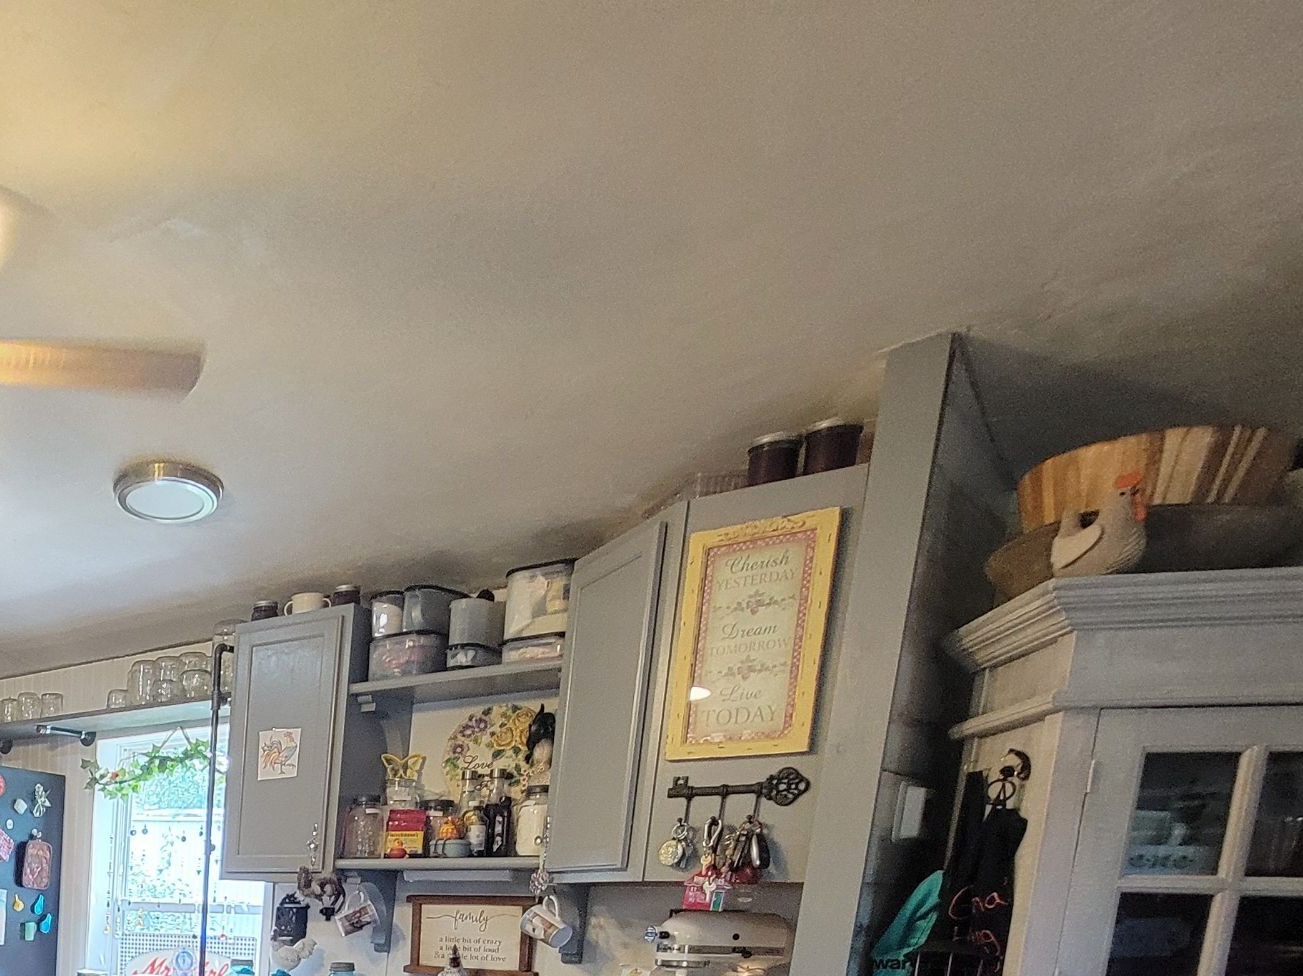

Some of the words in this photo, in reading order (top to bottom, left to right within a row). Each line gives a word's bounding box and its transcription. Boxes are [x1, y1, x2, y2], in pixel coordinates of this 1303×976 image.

[725, 550, 791, 575] Cherish
[716, 568, 798, 592] YESTERDAY
[721, 622, 778, 641] Dream
[708, 637, 792, 658] TOMORROW
[719, 684, 763, 703] Live
[701, 704, 778, 729] TODAY
[460, 754, 494, 771] Love
[452, 909, 489, 933] family
[444, 935, 460, 944] little
[482, 939, 502, 947] crazy
[480, 954, 489, 962] of
